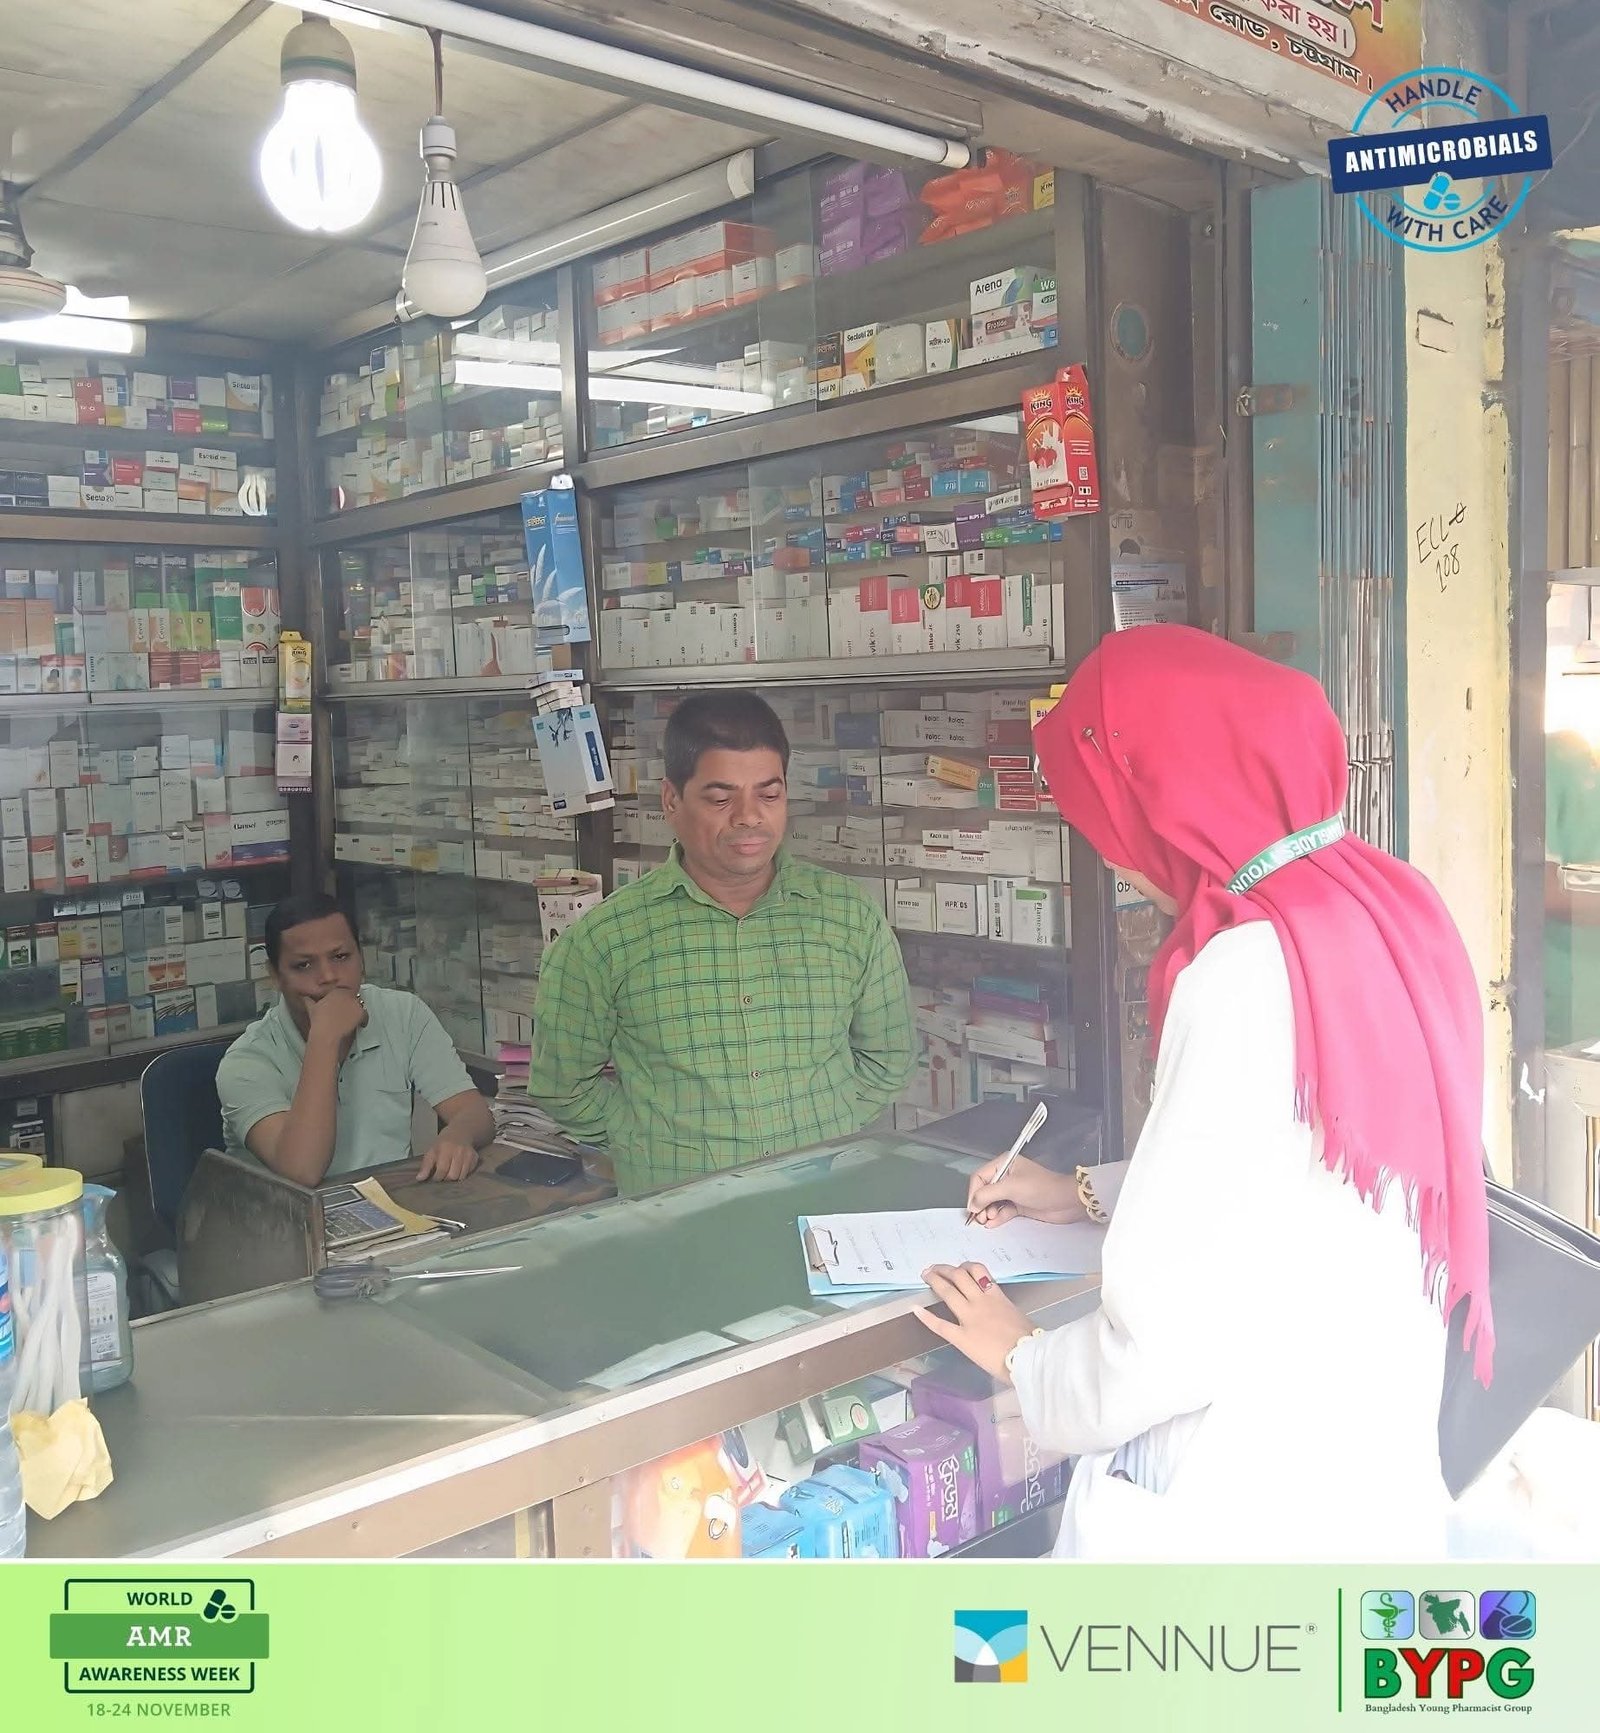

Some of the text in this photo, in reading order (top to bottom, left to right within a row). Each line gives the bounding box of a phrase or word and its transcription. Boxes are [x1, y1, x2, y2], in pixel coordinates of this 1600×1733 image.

[1040, 177, 1055, 193] KIN
[975, 278, 1002, 296] Arena
[1030, 397, 1052, 412] KING
